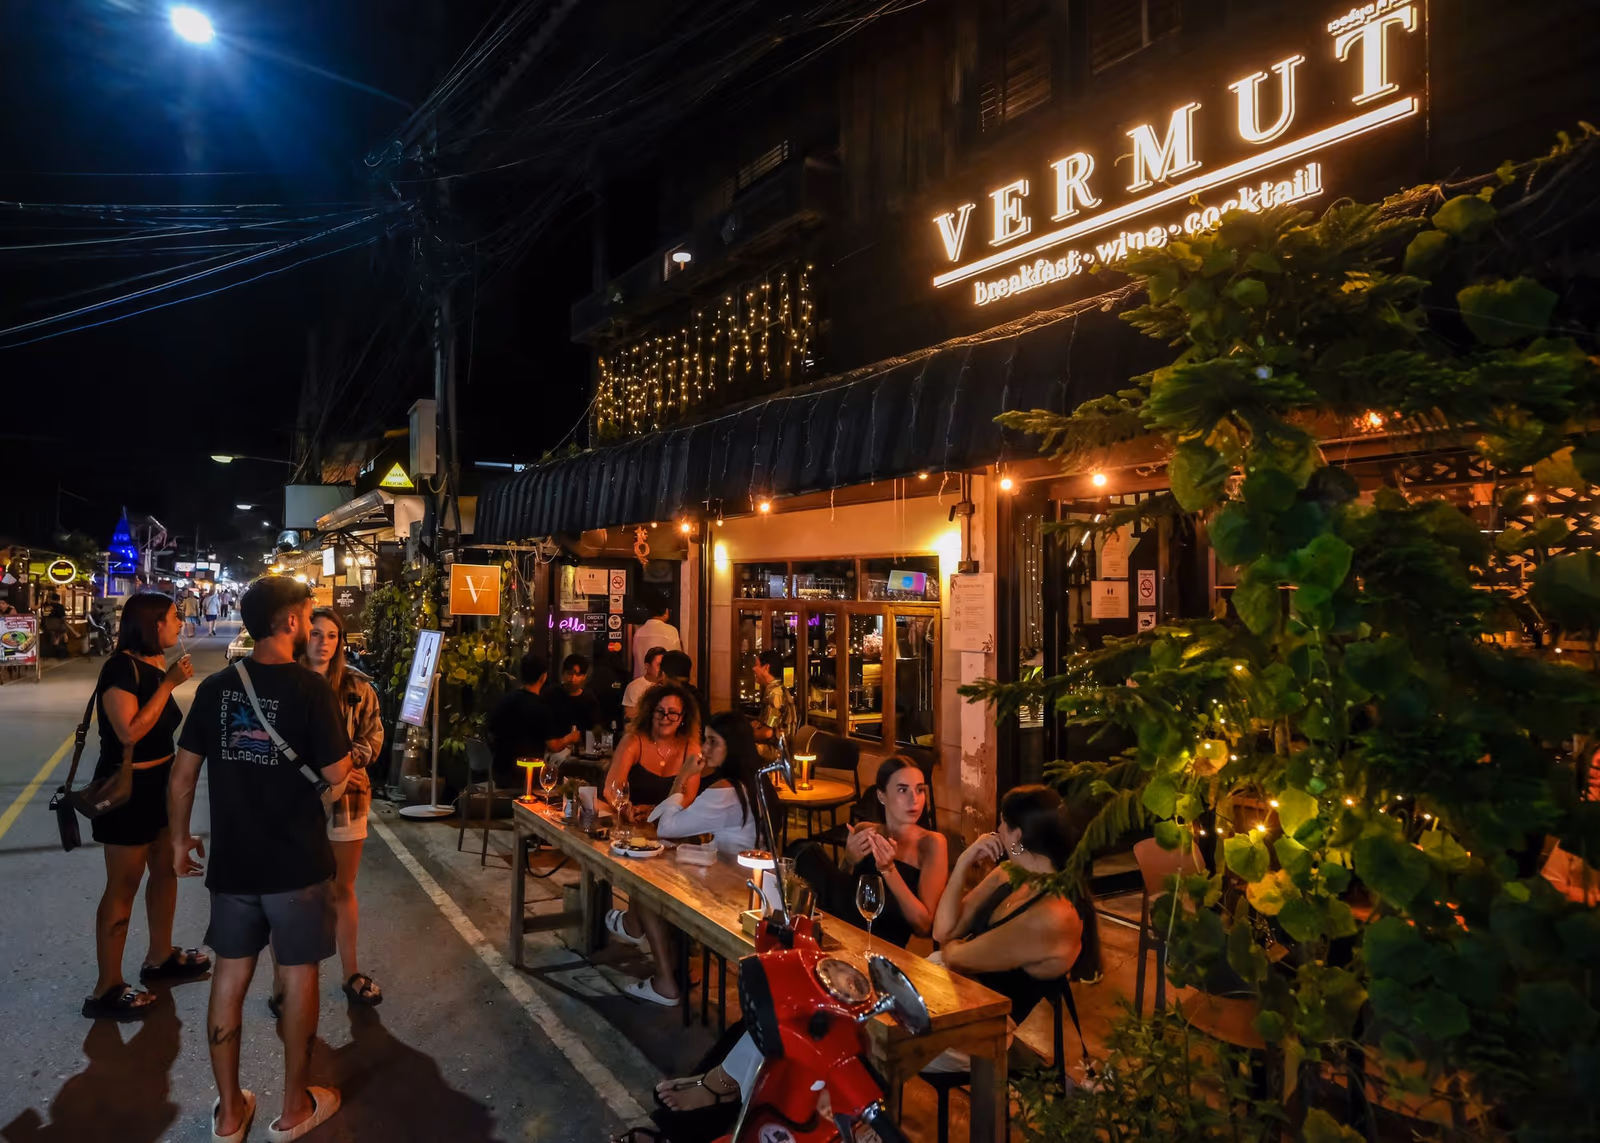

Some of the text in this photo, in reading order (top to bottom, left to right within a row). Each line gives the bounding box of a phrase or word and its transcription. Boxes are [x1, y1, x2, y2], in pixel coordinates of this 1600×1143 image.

[933, 6, 1417, 264] VERMUT
[974, 249, 1083, 306] breakfast
[1096, 226, 1168, 265] wine
[464, 575, 490, 604] V
[231, 691, 280, 711] BILLONG
[267, 712, 279, 766] BIONG
